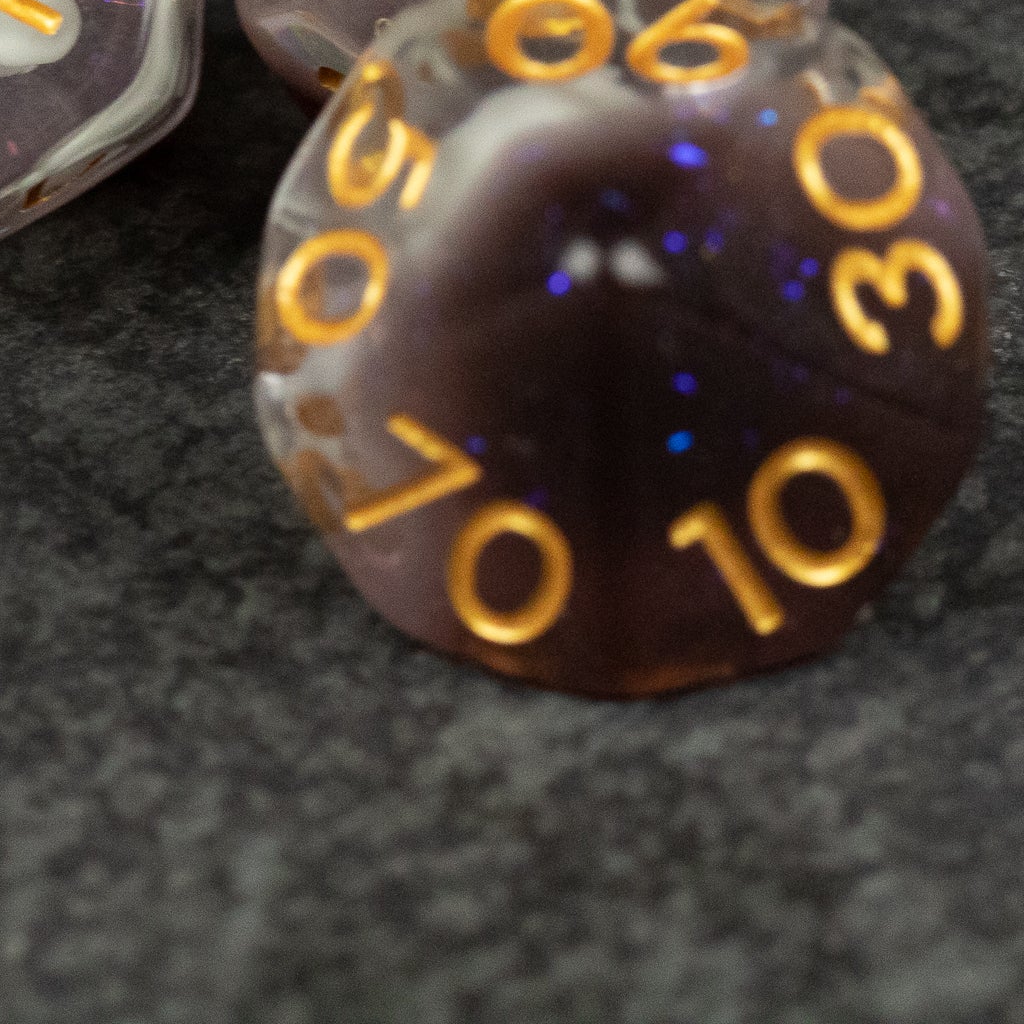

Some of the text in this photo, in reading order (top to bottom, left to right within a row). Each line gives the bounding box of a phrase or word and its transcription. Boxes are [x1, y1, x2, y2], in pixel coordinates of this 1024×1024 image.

[791, 104, 964, 356] 30
[346, 413, 574, 645] 70
[668, 436, 886, 636] 10
